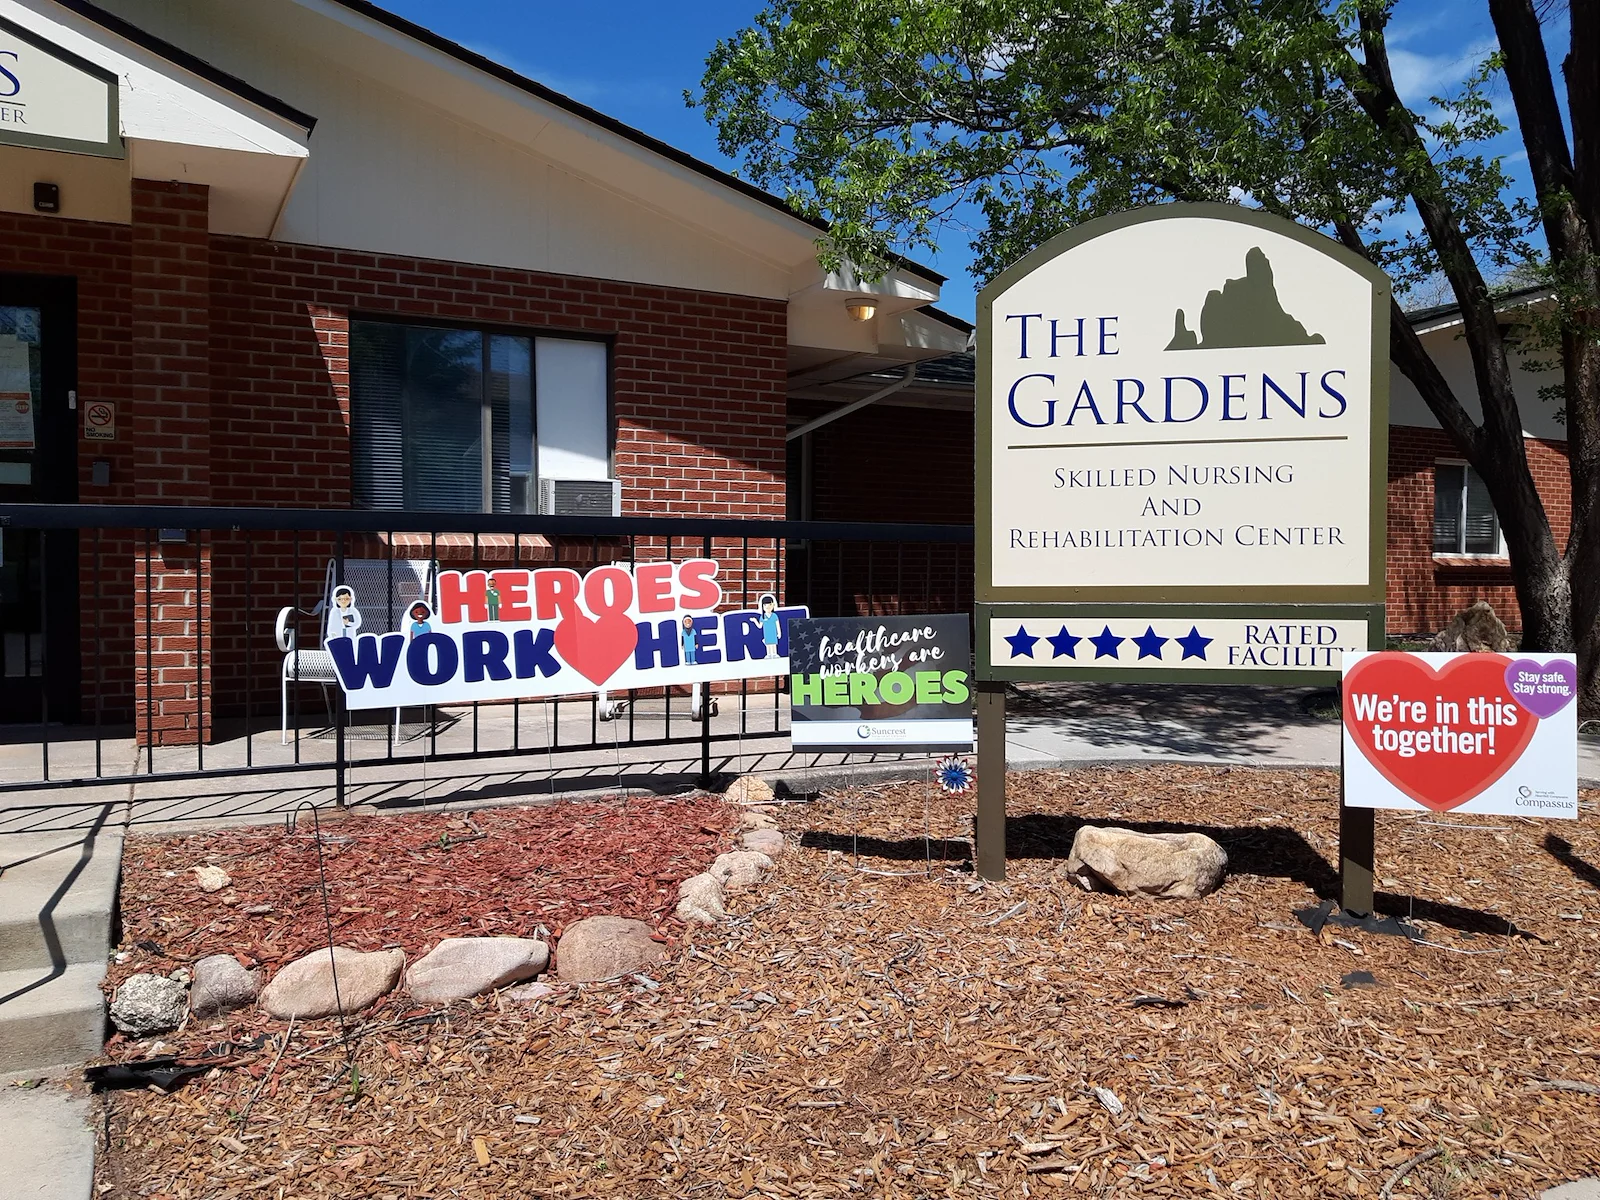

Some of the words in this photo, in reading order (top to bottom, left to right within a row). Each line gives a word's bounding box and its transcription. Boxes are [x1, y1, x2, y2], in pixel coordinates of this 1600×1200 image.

[1005, 313, 1121, 359] THE
[1007, 370, 1348, 428] GARDENS
[1054, 467, 1156, 489] SKILLED
[1167, 464, 1295, 485] NURSING
[1140, 496, 1202, 517] AND
[1008, 527, 1224, 549] REHABILITATION
[1234, 524, 1347, 547] CENTER
[439, 560, 719, 624] HEROES
[818, 625, 937, 661] healthcare
[1244, 624, 1338, 646] RATED
[327, 628, 562, 691] WORK
[818, 652, 902, 680] workers
[908, 645, 946, 662] are
[1226, 645, 1357, 667] FACILIT
[791, 669, 970, 706] HEROES
[1513, 682, 1535, 695] Stay
[1536, 685, 1572, 697] strong.
[1518, 671, 1541, 685] Stay
[1542, 672, 1567, 683] safe.
[1436, 695, 1459, 724] in
[1467, 697, 1519, 727] this
[871, 727, 906, 735] Suncrest
[1372, 724, 1496, 758] together!
[1515, 797, 1574, 809] Compassus
